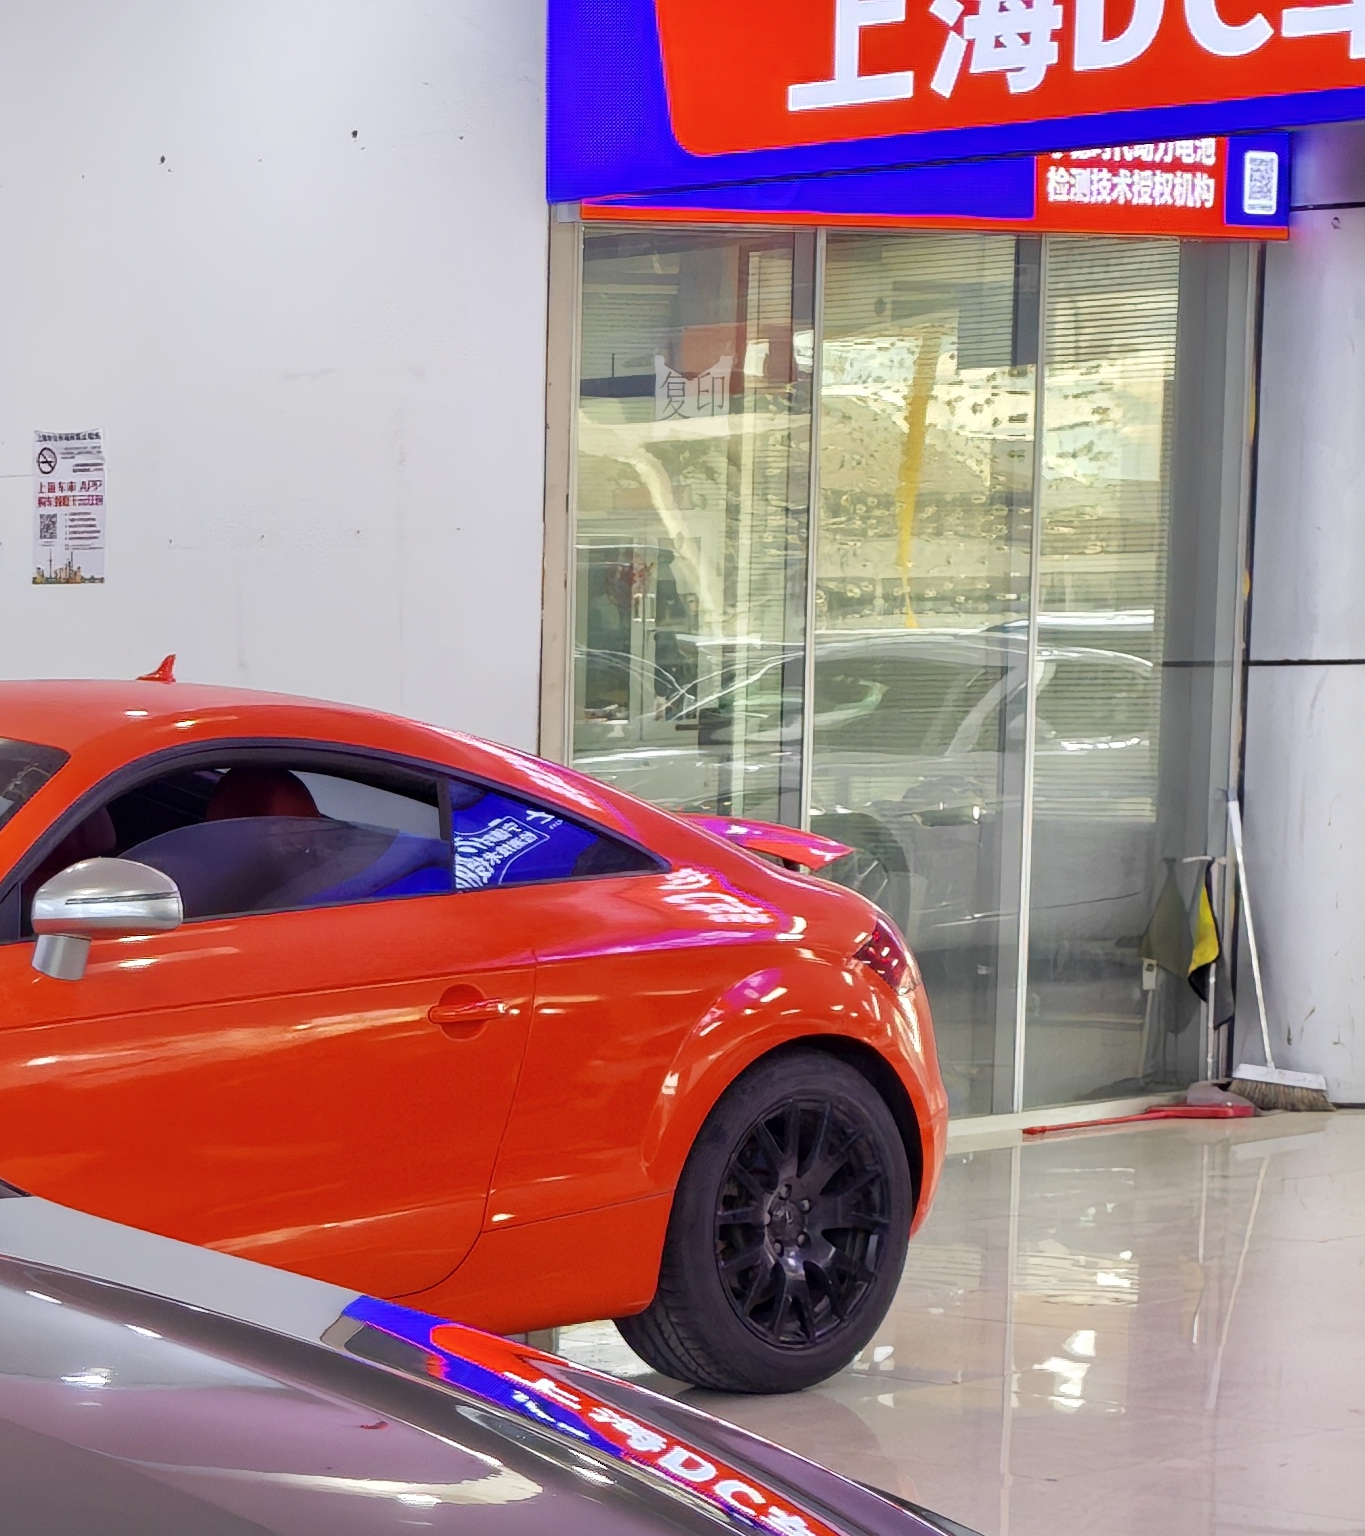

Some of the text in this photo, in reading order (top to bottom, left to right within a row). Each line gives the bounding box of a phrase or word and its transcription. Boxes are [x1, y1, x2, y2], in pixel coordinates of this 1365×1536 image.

[787, 0, 1365, 111] 上海DC
[1046, 166, 1215, 208] 检测技术授权机构
[660, 371, 725, 421] 复印
